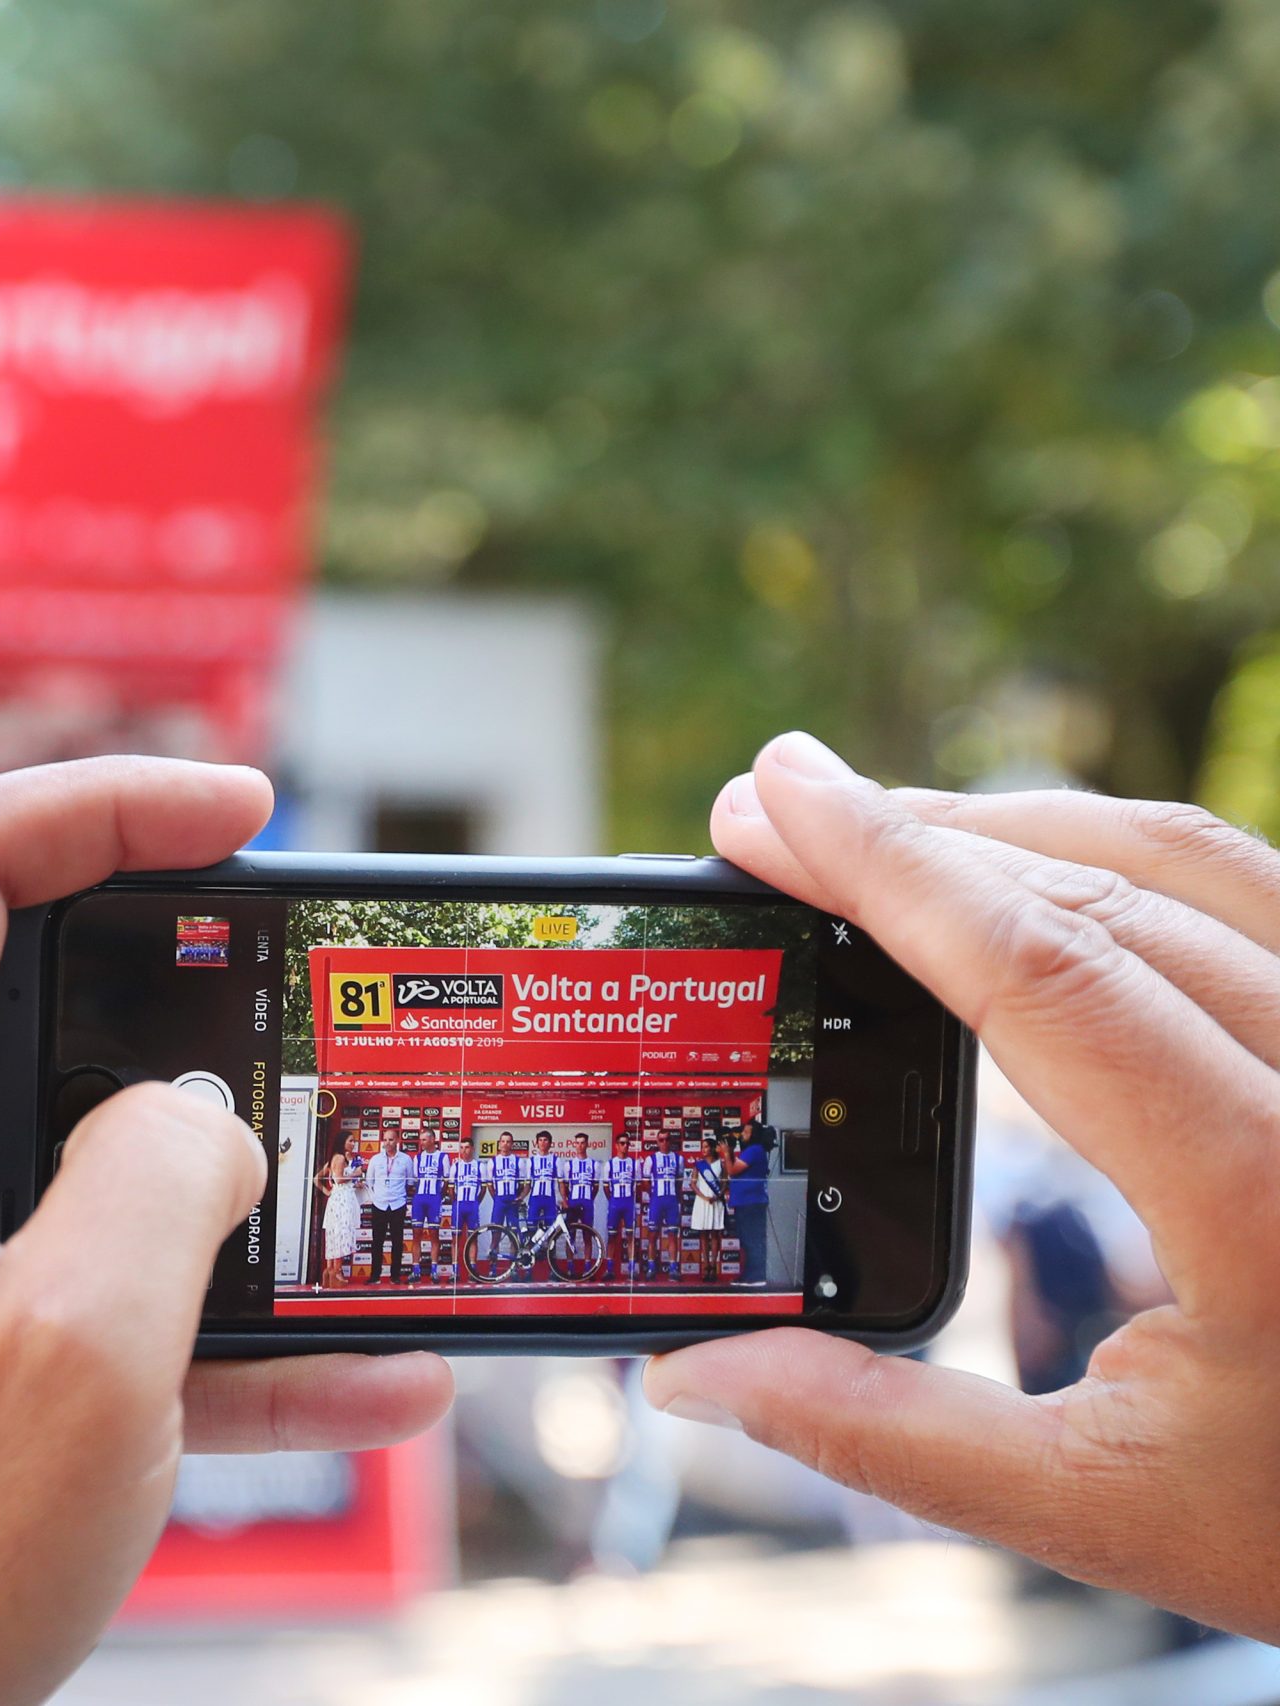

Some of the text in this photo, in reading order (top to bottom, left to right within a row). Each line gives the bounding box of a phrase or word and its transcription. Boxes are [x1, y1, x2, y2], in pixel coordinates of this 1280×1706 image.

[540, 922, 571, 935] LIVE
[257, 929, 269, 962] LENTA
[441, 979, 498, 995] VOLTA
[511, 973, 765, 1008] Volta a Portugal
[442, 996, 498, 1005] A PORTUGAL
[254, 988, 271, 1032] VÍDEO
[421, 1015, 498, 1030] Santander
[512, 1006, 677, 1033] Santander
[822, 1018, 852, 1030] HDR
[335, 1036, 504, 1047] 31 JULHO A 11 AGOSTO 2019
[251, 1061, 266, 1140] FOTOGRAF
[520, 1105, 564, 1118] VISEU
[481, 1143, 495, 1154] 81
[248, 1202, 262, 1264] ADRADO
